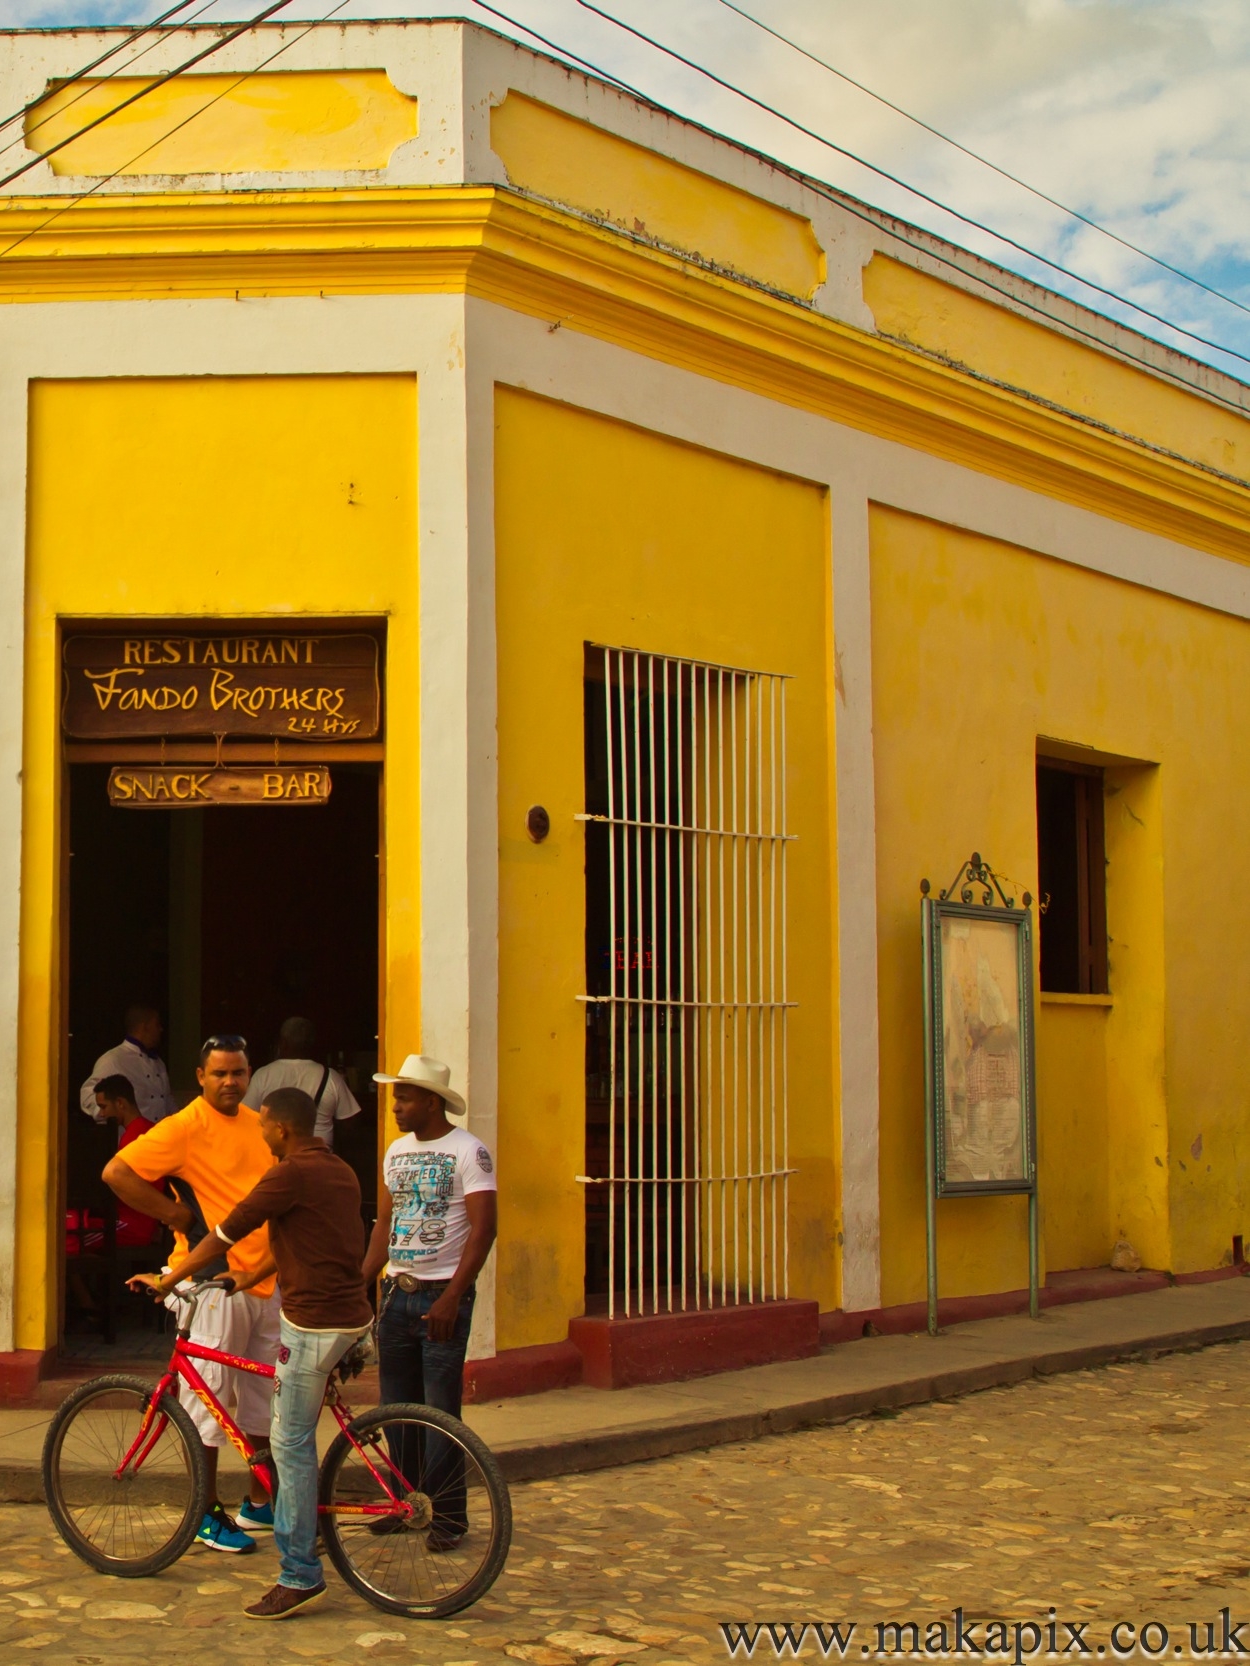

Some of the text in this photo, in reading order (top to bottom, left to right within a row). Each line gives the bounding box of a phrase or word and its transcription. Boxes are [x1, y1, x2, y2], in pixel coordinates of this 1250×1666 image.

[123, 639, 319, 664] RESTAURANT
[210, 667, 346, 719] BROTHERS
[287, 717, 317, 734] 24
[113, 774, 213, 800] SNACK
[262, 772, 322, 799] BAR
[400, 1219, 447, 1245] 78
